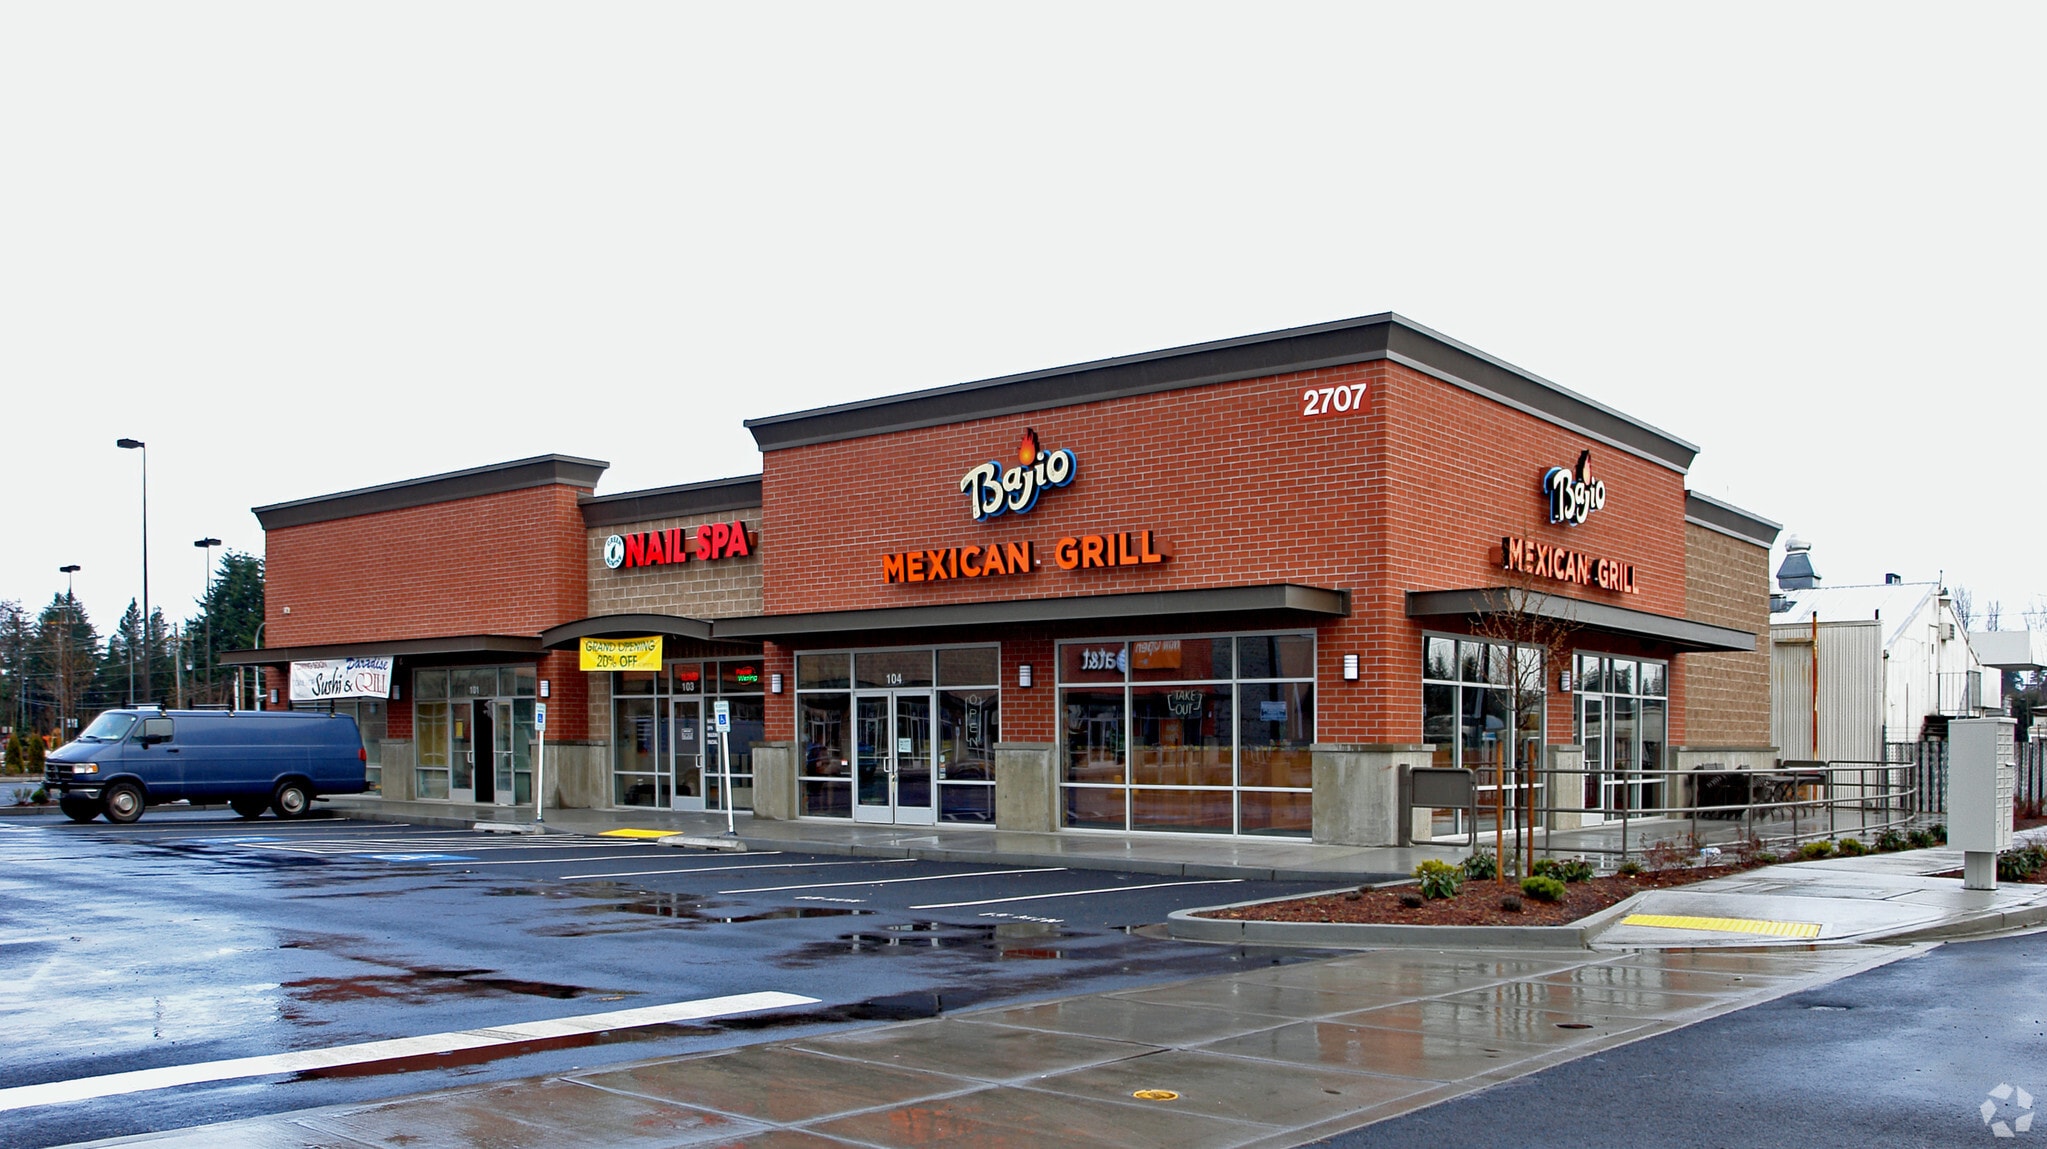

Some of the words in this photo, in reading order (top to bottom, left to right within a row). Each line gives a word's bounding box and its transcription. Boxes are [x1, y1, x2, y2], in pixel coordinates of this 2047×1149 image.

[1303, 383, 1366, 416] 2707
[960, 449, 1076, 521] Bajio
[1551, 466, 1606, 525] Bajio
[626, 528, 686, 568] NAIL
[696, 520, 748, 561] SPA
[883, 541, 1032, 584] MEXICAN
[1055, 530, 1162, 570] GRILL
[1509, 537, 1588, 585] MEXICAN
[1597, 558, 1640, 595] GRILL
[585, 641, 616, 652] GRAND
[618, 640, 656, 652] OPENING
[345, 657, 389, 674] Paradise
[597, 654, 616, 668] 20%
[620, 655, 637, 668] OFF
[312, 667, 343, 696] Sushi
[344, 679, 353, 692] &
[469, 685, 480, 695] 101
[681, 681, 695, 692] 103
[886, 673, 902, 685] 104
[1175, 689, 1196, 701] TAKE
[969, 694, 979, 747] OPEN
[1175, 703, 1193, 716] OUT
